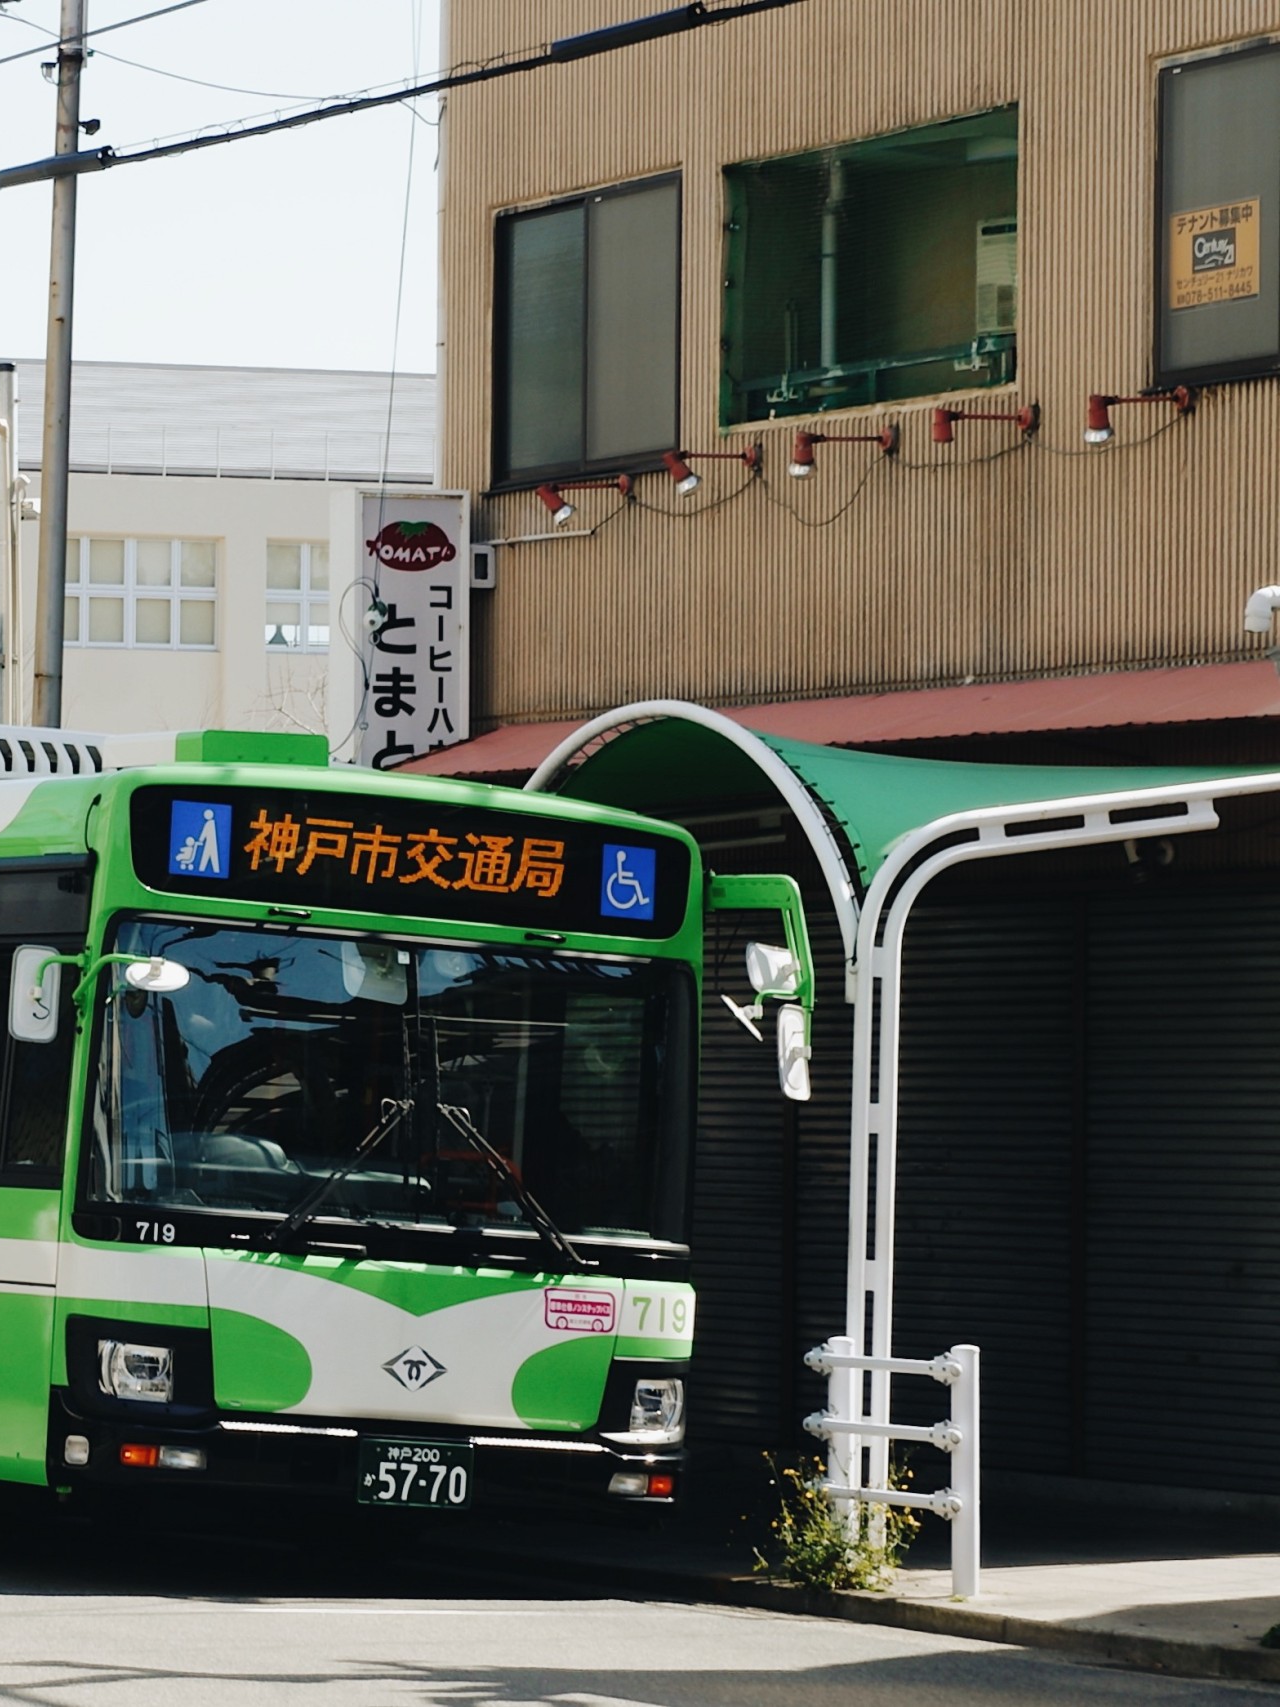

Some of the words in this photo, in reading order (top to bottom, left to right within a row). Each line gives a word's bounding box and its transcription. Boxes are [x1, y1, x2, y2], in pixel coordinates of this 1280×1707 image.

[427, 585, 454, 752] コーヒーハ
[244, 808, 566, 898] 神戸市交通局
[135, 1221, 176, 1243] 719
[632, 1297, 687, 1333] 719
